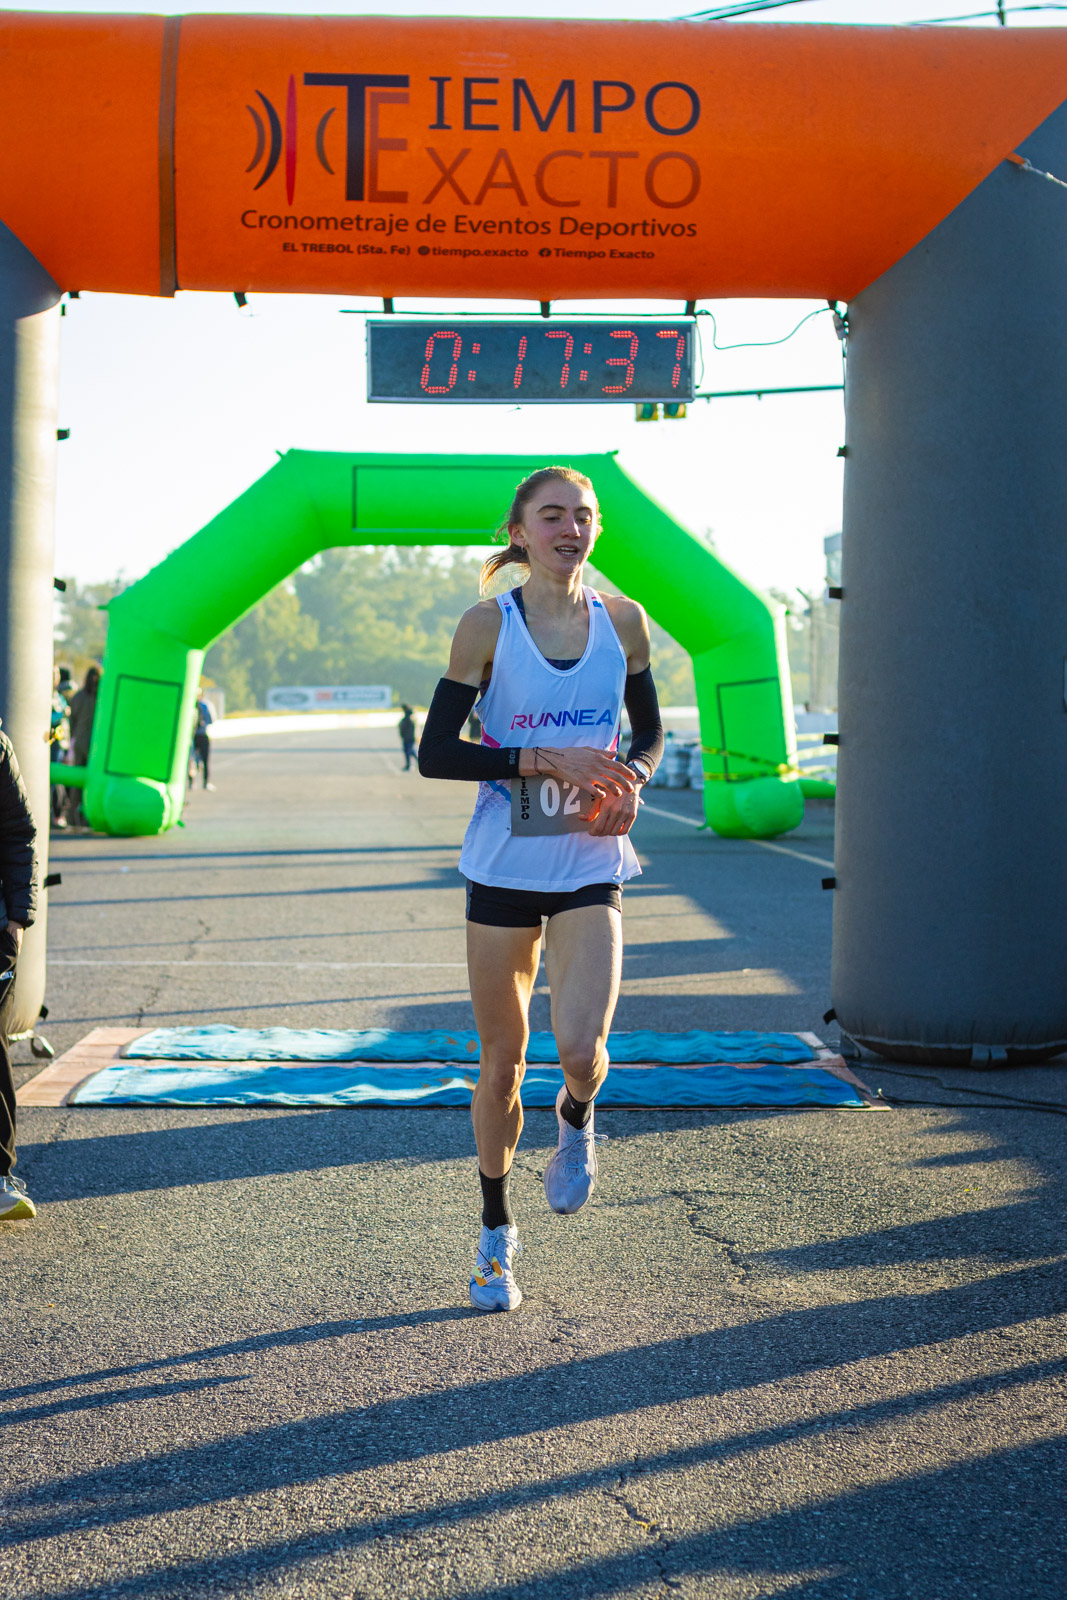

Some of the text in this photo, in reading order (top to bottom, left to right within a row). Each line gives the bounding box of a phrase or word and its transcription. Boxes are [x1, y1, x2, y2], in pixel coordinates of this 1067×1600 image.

[240, 209, 697, 240] Cronometraje de Eventos Deportivos
[282, 242, 655, 260] EL TREBOL (Sta. Fe) tiempo.exacto Tiempo Exacto
[420, 330, 685, 394] 0:17:37
[510, 709, 613, 730] RUNNEA
[540, 778, 580, 817] 02
